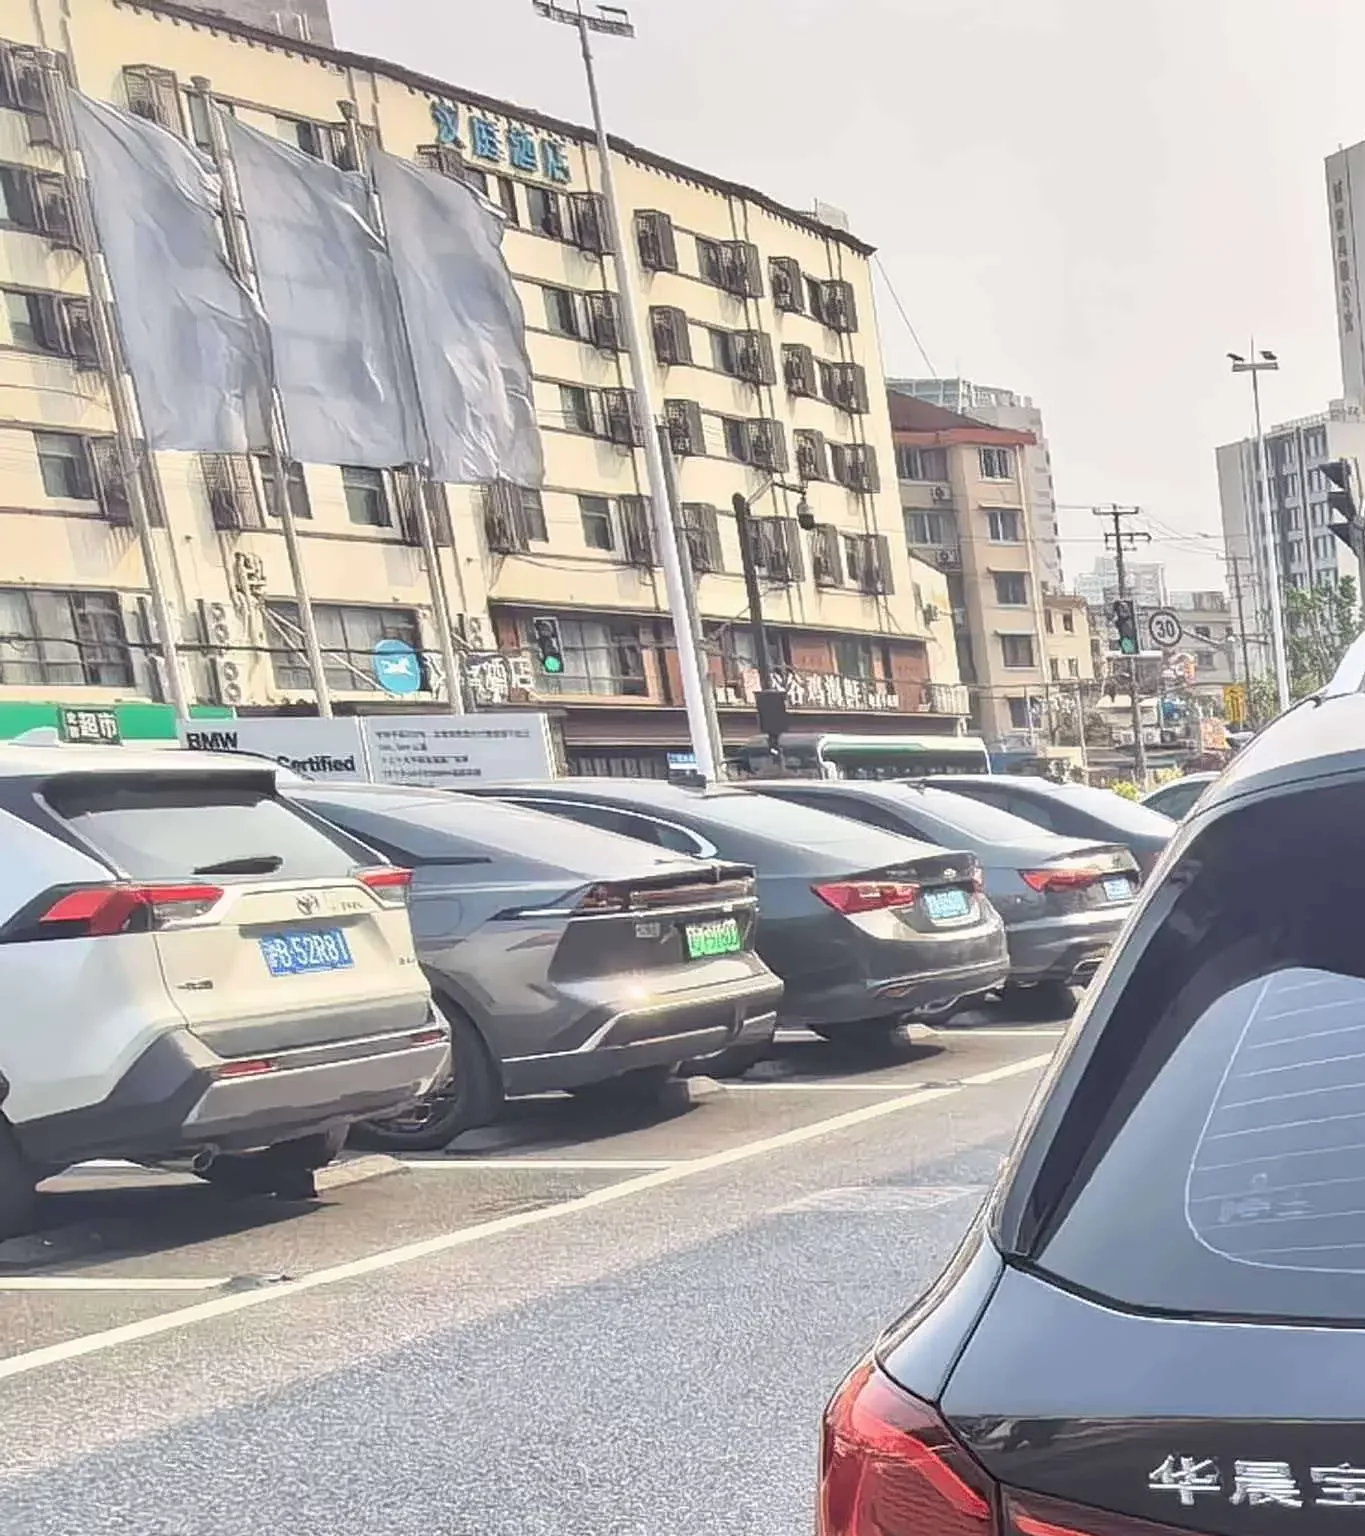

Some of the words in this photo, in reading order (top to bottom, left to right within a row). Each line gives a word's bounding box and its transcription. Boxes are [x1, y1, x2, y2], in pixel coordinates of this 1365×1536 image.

[1156, 620, 1175, 638] 30
[423, 653, 534, 702] 汉酒店
[187, 732, 238, 750] BMW
